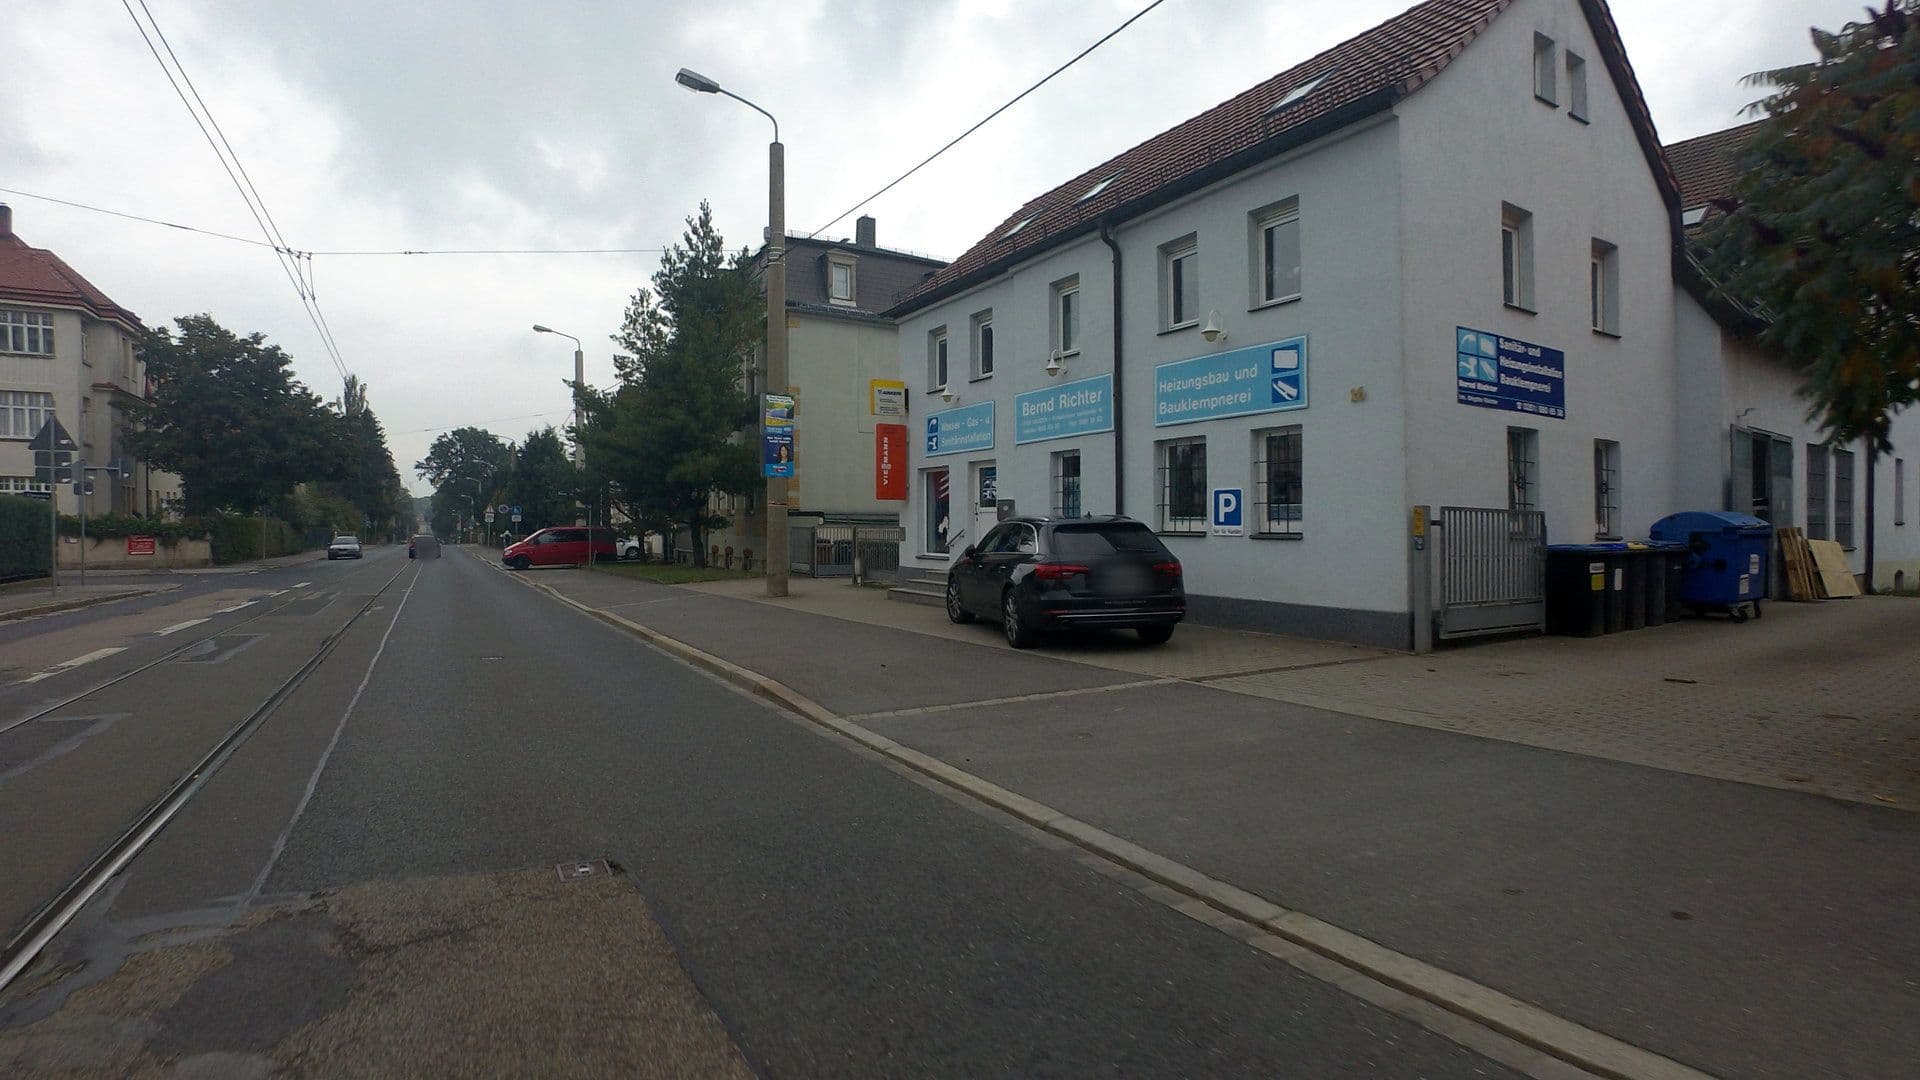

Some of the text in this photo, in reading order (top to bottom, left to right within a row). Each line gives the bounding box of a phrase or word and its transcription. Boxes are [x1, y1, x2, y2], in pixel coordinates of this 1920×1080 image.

[1160, 363, 1258, 393] Heizungsbau und
[1022, 389, 1103, 417] Bernd Richter
[1159, 388, 1252, 415] Bauklempnerei
[1219, 494, 1236, 522] P
